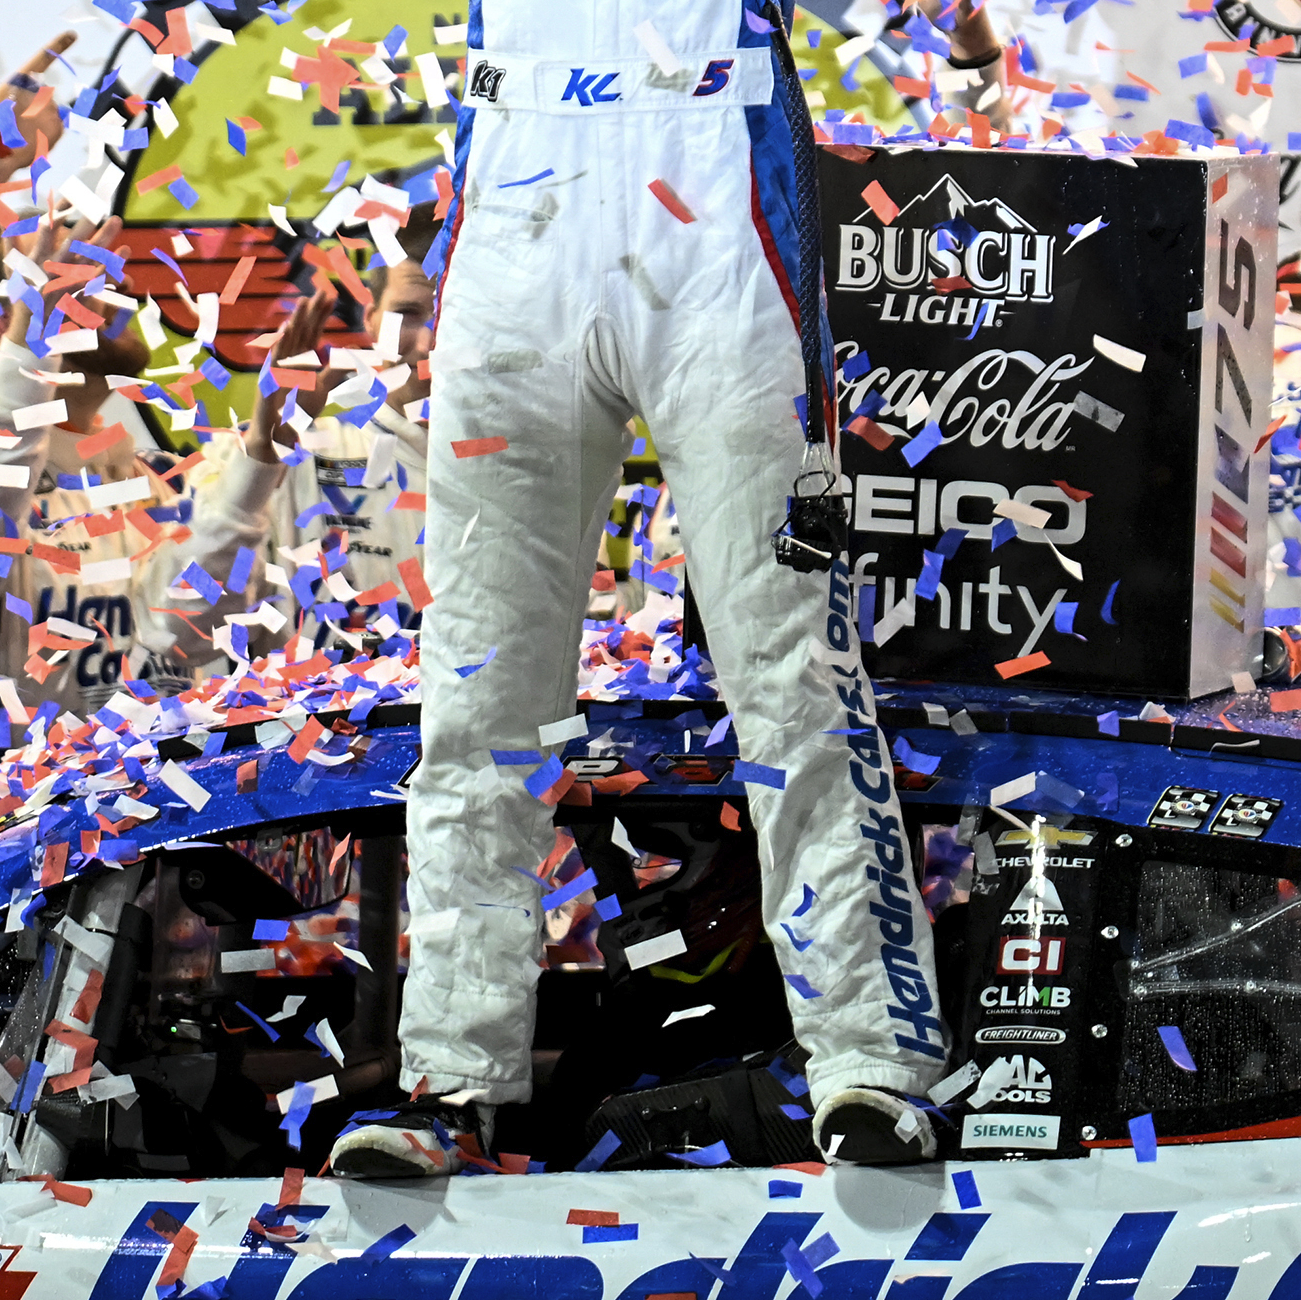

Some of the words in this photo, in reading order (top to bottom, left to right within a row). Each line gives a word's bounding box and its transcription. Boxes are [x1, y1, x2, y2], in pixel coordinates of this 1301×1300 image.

[470, 59, 506, 102] K1
[692, 59, 735, 96] 5
[835, 223, 1056, 302] BUSCH
[879, 293, 1006, 327] LIGHT
[841, 473, 1087, 544] EICO
[848, 552, 1068, 659] finity
[994, 856, 1095, 869] CHEVROLET
[1001, 912, 1069, 925] AXALTA
[861, 814, 946, 1061] Hendrick
[1001, 939, 1061, 972] CI
[979, 985, 1071, 1008] CLIMB
[984, 1029, 1058, 1041] FREIGHTLINER
[978, 1054, 1052, 1090] AC
[990, 1090, 1051, 1103] OOLS
[973, 1124, 1048, 1138] SIEMENS
